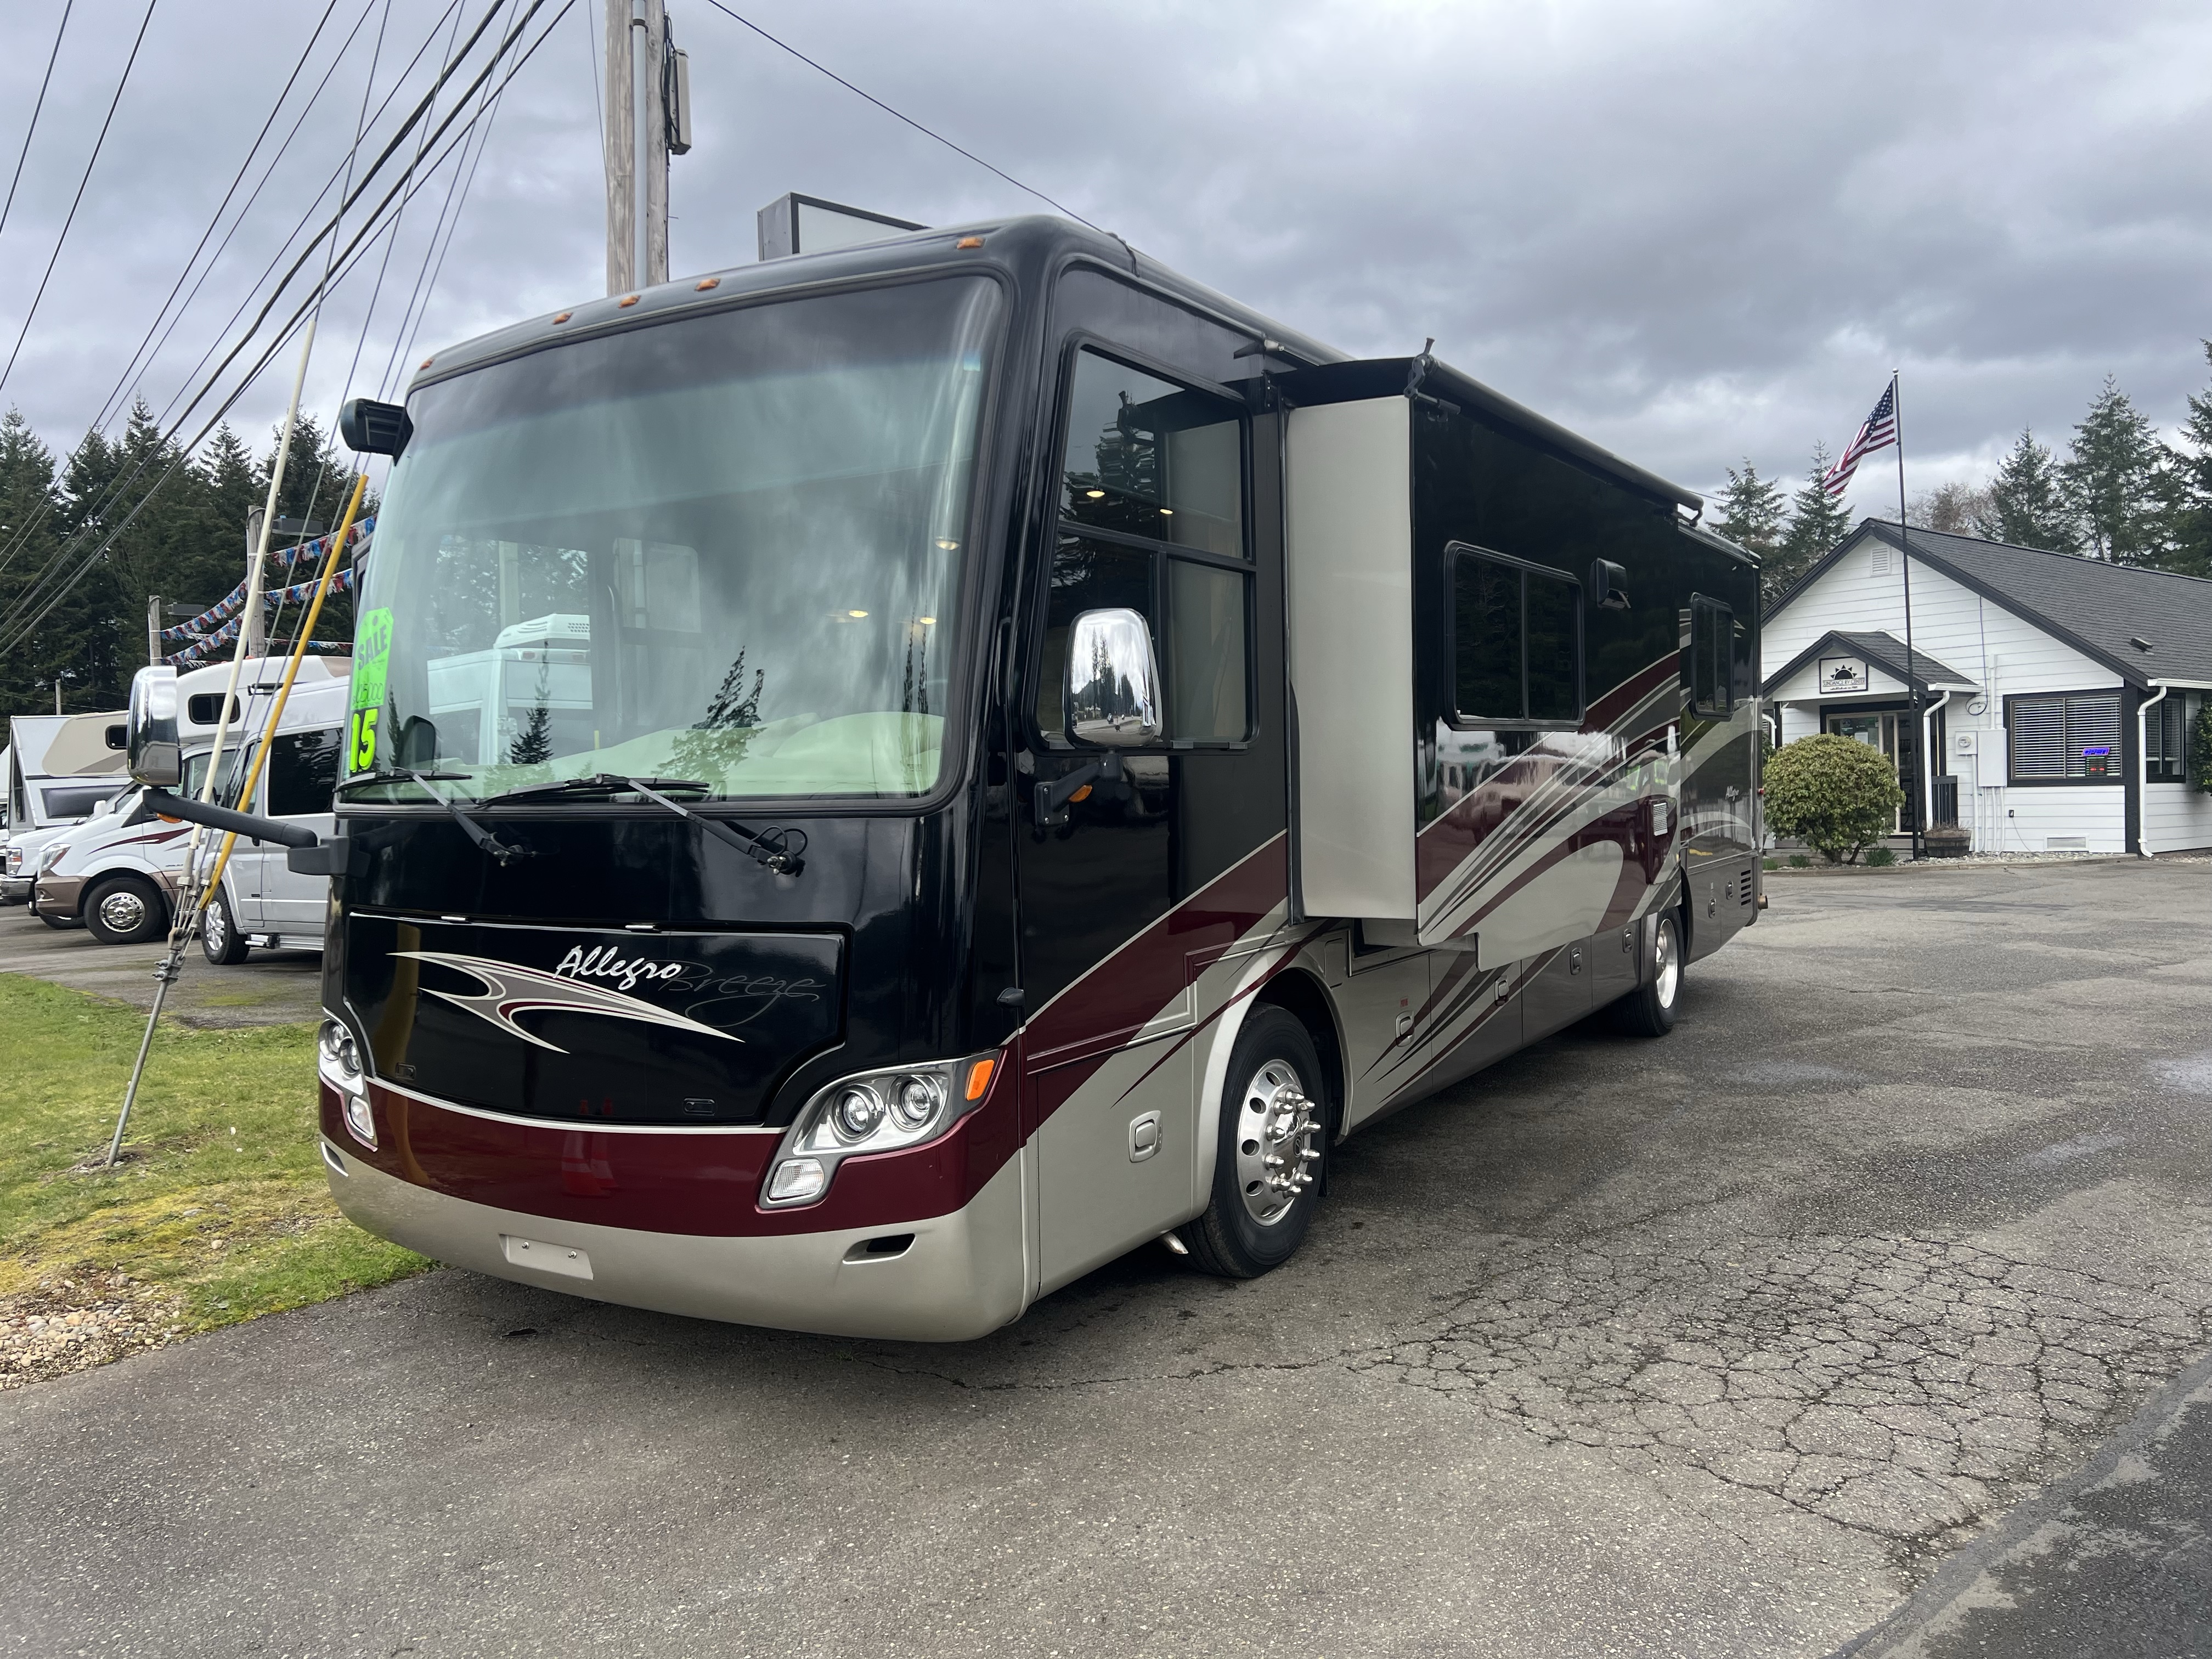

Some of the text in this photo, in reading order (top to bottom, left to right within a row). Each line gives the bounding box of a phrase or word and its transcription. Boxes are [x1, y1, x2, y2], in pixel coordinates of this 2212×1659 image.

[358, 624, 387, 670] SALE
[349, 708, 378, 772] 15
[552, 945, 827, 1028] Allegro Breeze
